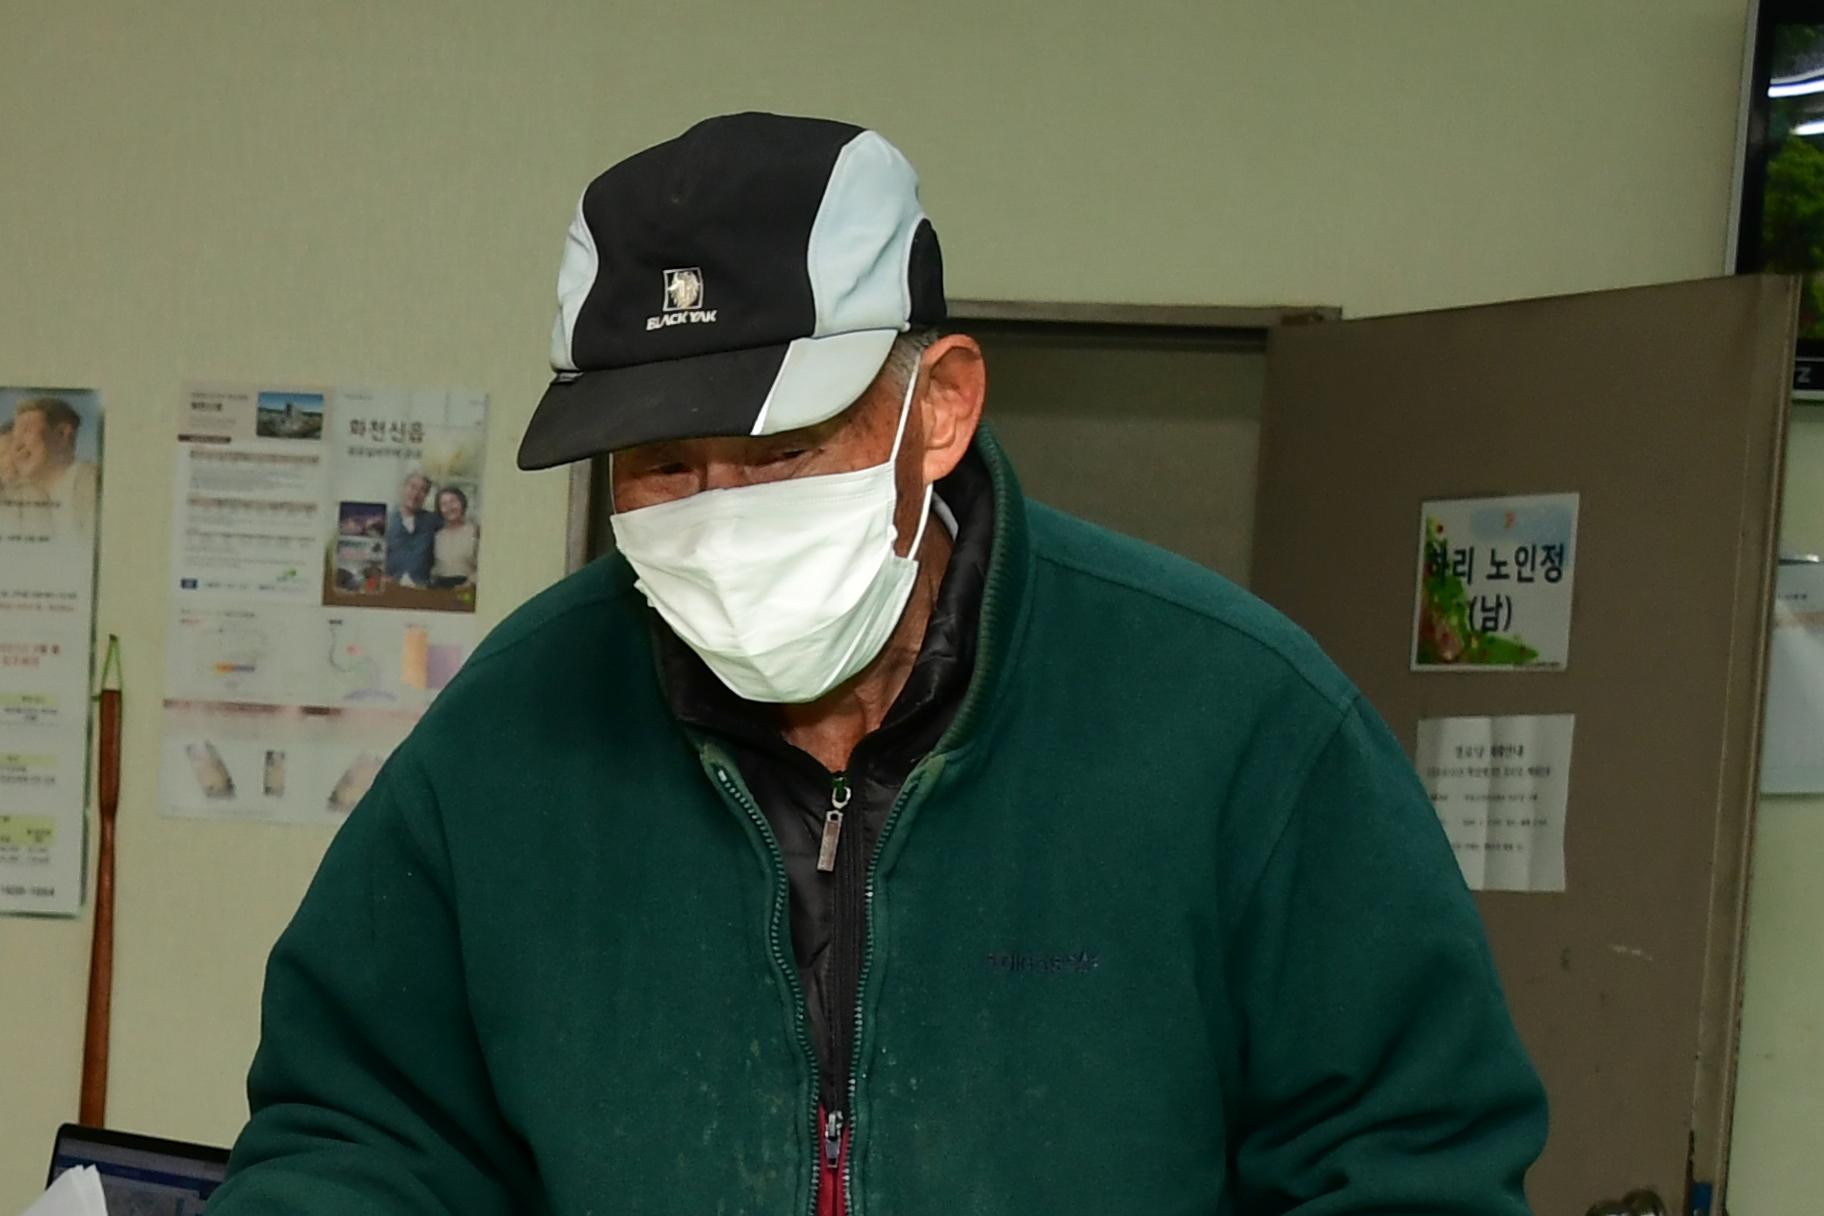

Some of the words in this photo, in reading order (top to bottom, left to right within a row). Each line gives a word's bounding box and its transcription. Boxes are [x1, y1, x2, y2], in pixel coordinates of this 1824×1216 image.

[646, 311, 688, 331] BLACK
[690, 310, 718, 323] YAK
[1486, 543, 1565, 583] 노인정
[1469, 594, 1512, 632] (남)
